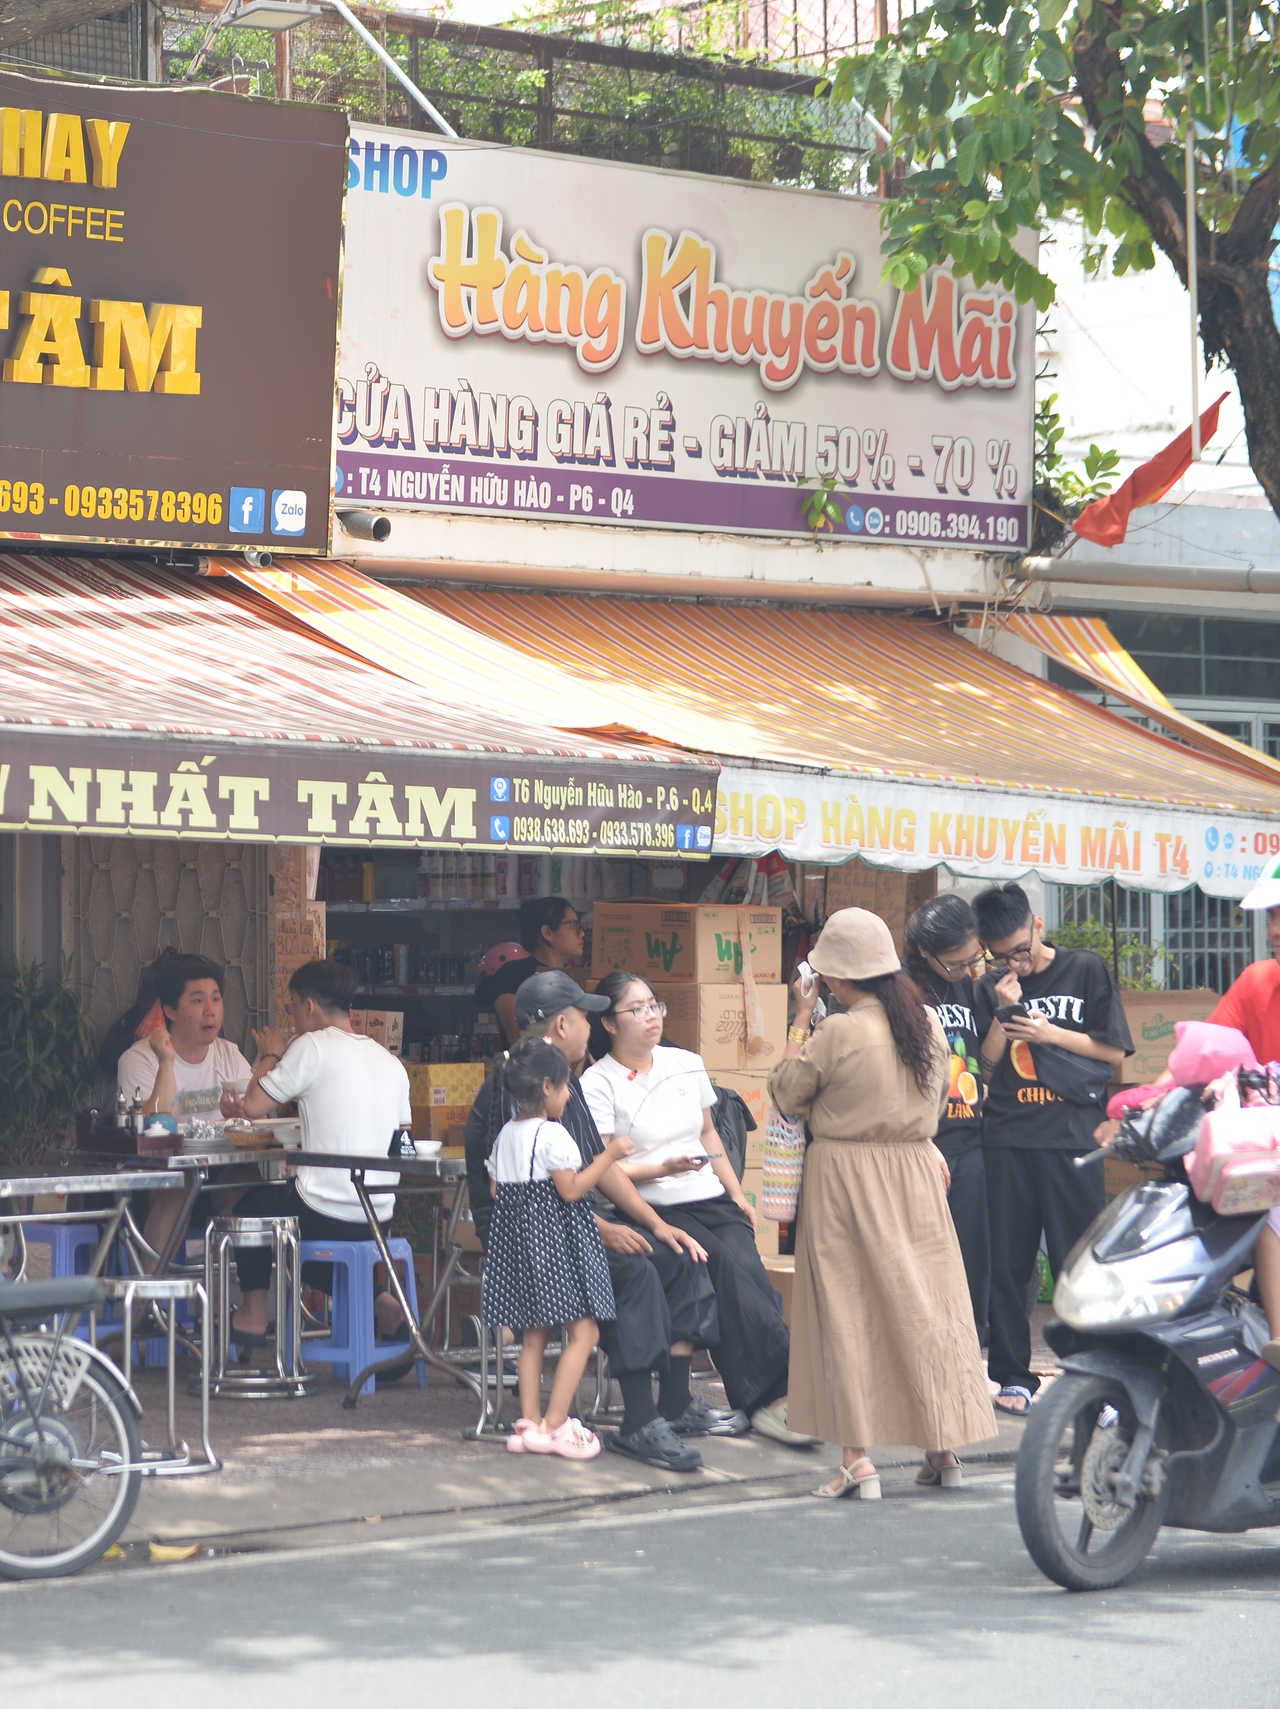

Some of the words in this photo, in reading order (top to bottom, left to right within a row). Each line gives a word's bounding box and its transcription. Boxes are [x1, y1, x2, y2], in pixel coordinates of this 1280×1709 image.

[348, 137, 448, 200] SHOP
[3, 199, 125, 242] COFFEE
[429, 203, 625, 371] Hàng
[637, 231, 879, 387] Khuyến
[888, 271, 1016, 387] Mãi
[337, 362, 414, 450] CỬA
[422, 378, 538, 461] HÀNG
[546, 392, 616, 466] GIÁ
[623, 390, 675, 472] RẺ
[709, 401, 806, 480] GIẢM
[815, 424, 895, 490] 50%
[931, 435, 974, 496] 70
[63, 484, 223, 525] 0933578396
[281, 503, 304, 516] Zalo
[359, 467, 381, 496] T4
[387, 463, 464, 502] NGUYỄN
[470, 471, 508, 506] HỮU
[513, 475, 551, 509] HÀO
[570, 485, 593, 512] P6
[611, 488, 634, 517] Q4
[895, 509, 1019, 542] 0906.394.190
[28, 755, 270, 831] NHẤT
[297, 771, 477, 839] TÂM
[513, 777, 530, 805] T6
[534, 776, 583, 811] Nguyễn
[587, 781, 614, 809] Hữu
[618, 783, 643, 810] Hào
[656, 786, 679, 812] P.6
[691, 787, 713, 815] Q.4
[513, 816, 590, 845] 0938.638.693
[599, 820, 675, 848] 0933.578.396
[715, 790, 808, 845] SHOP
[821, 794, 918, 854] HÀNG
[928, 808, 1068, 870] KHUYẾN
[1079, 820, 1145, 874] MÃI
[1154, 830, 1191, 880] T4
[1224, 863, 1238, 879] T4
[400, 1130, 411, 1145] 4
